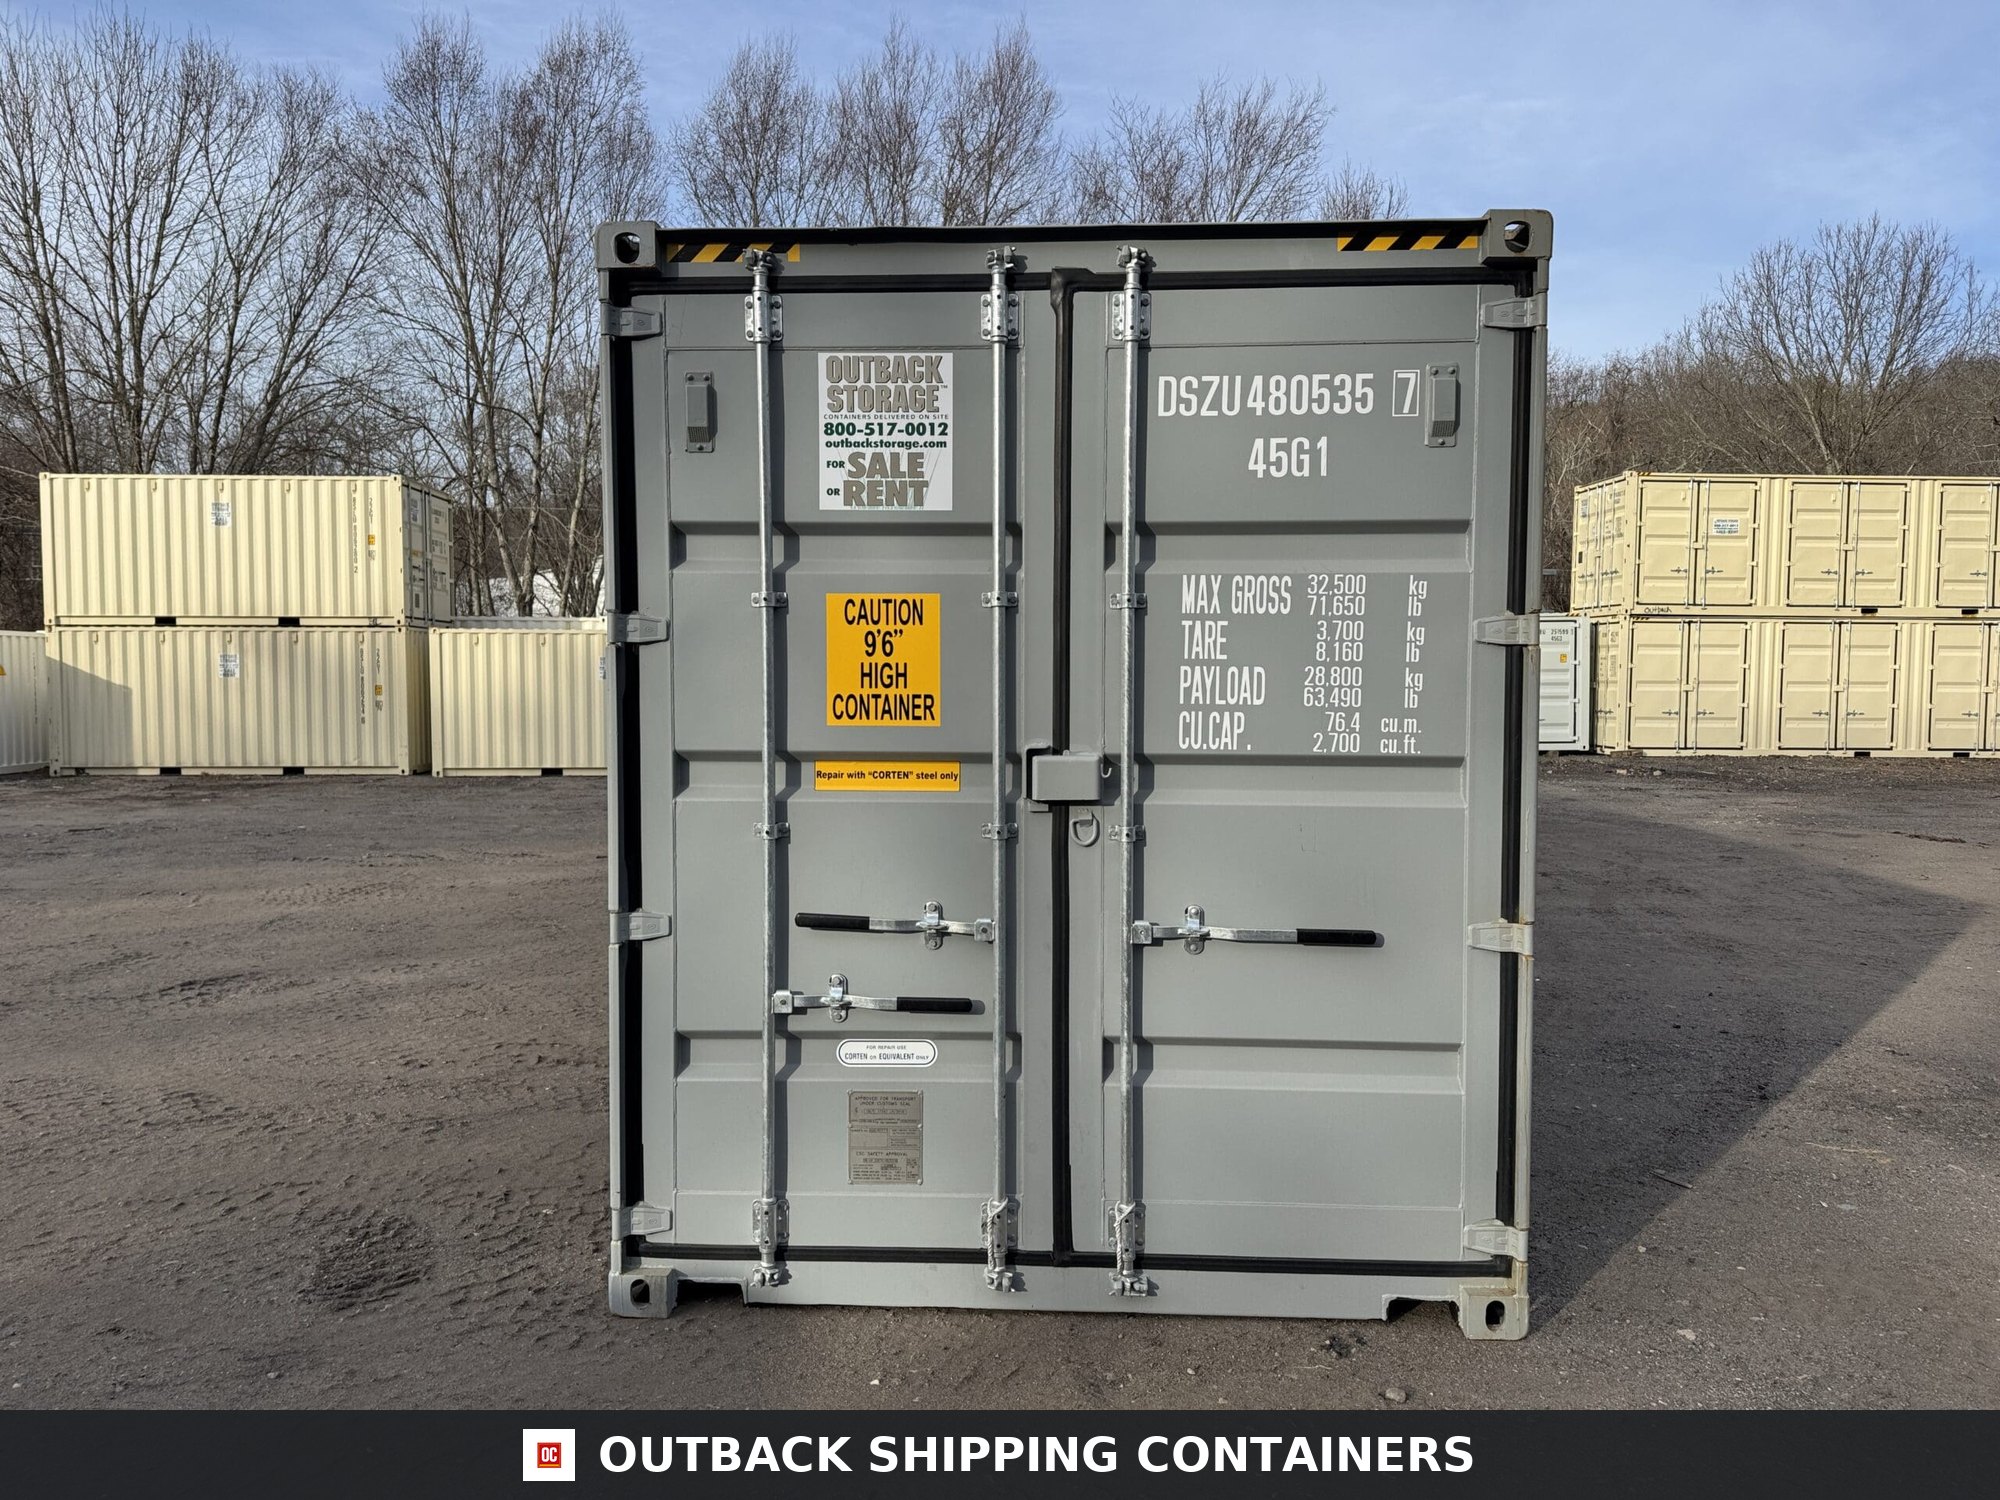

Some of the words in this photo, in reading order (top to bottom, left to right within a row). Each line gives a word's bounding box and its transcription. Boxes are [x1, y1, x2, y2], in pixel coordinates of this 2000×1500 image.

[826, 355, 944, 384] OUTBACK
[827, 384, 940, 413] STORAGE
[1397, 372, 1417, 414] 7
[824, 422, 949, 436] 800-517-0012
[825, 438, 947, 450] outbackstorage.com
[1248, 436, 1328, 478] 45G1
[826, 461, 845, 469] FOR
[847, 451, 925, 479] SALE
[826, 488, 840, 496] OR
[843, 480, 929, 507] RENT
[1181, 574, 1222, 614] MAX
[1231, 575, 1292, 615] GROSS
[1307, 574, 1367, 596] 32,500
[1409, 574, 1428, 599] kg
[844, 598, 924, 626] CAUTION
[1308, 595, 1366, 617] 71,650
[1407, 596, 1422, 617] lb
[1181, 620, 1229, 660] TARE
[1316, 620, 1364, 642] 3,700
[1406, 621, 1425, 645] kg
[1315, 641, 1363, 663] 8,160
[1405, 642, 1420, 663] lb
[860, 662, 908, 689] HIGH
[1179, 665, 1266, 706] PAYLOAD
[1304, 666, 1363, 687] 28,800
[1404, 667, 1424, 691] kg
[832, 694, 935, 721] CONTAINER
[1303, 687, 1362, 709] 63,490
[1404, 687, 1418, 708] lb
[1325, 711, 1361, 732] 76.4
[1380, 717, 1422, 733] cu.m.
[1312, 732, 1361, 754] 2,700
[1380, 736, 1421, 754] cu.ft.
[816, 770, 844, 780] Repair
[847, 770, 866, 779] with
[916, 771, 938, 780] steel
[940, 772, 959, 782] only
[845, 1052, 868, 1060] CORTEN
[879, 1052, 914, 1060] EQUIVALENT
